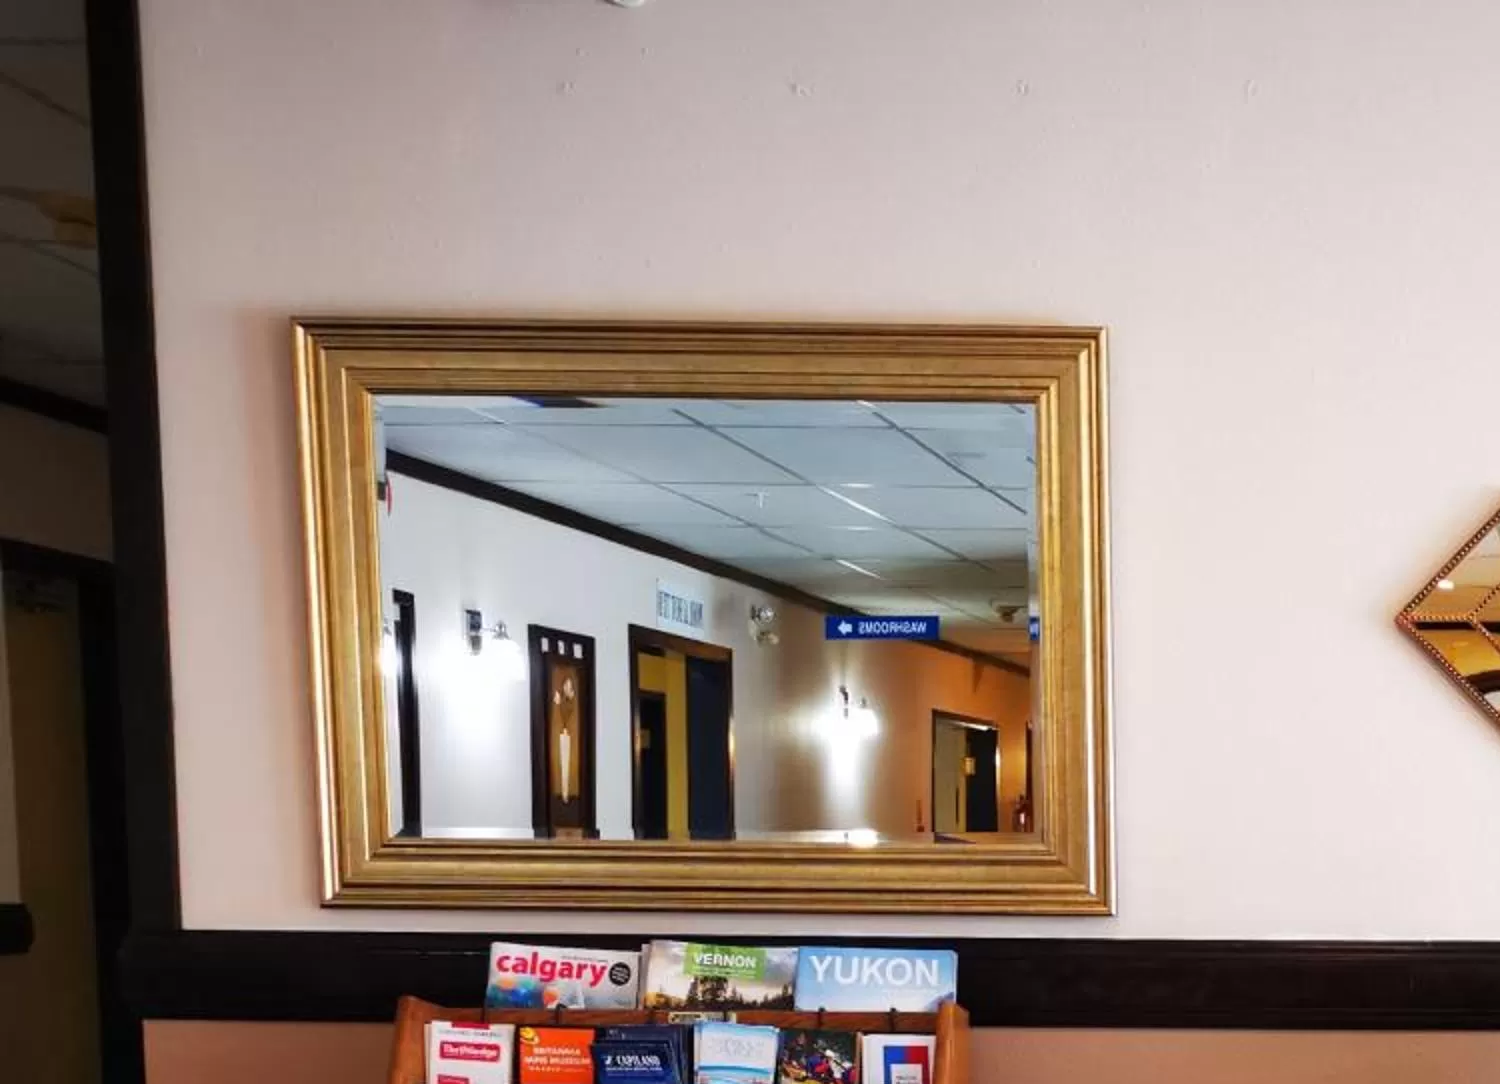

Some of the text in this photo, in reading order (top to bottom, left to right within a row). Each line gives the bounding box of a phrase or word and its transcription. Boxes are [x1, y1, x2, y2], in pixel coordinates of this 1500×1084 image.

[496, 952, 608, 988] calgary
[692, 952, 757, 969] VERNON
[809, 954, 940, 987] YUKON
